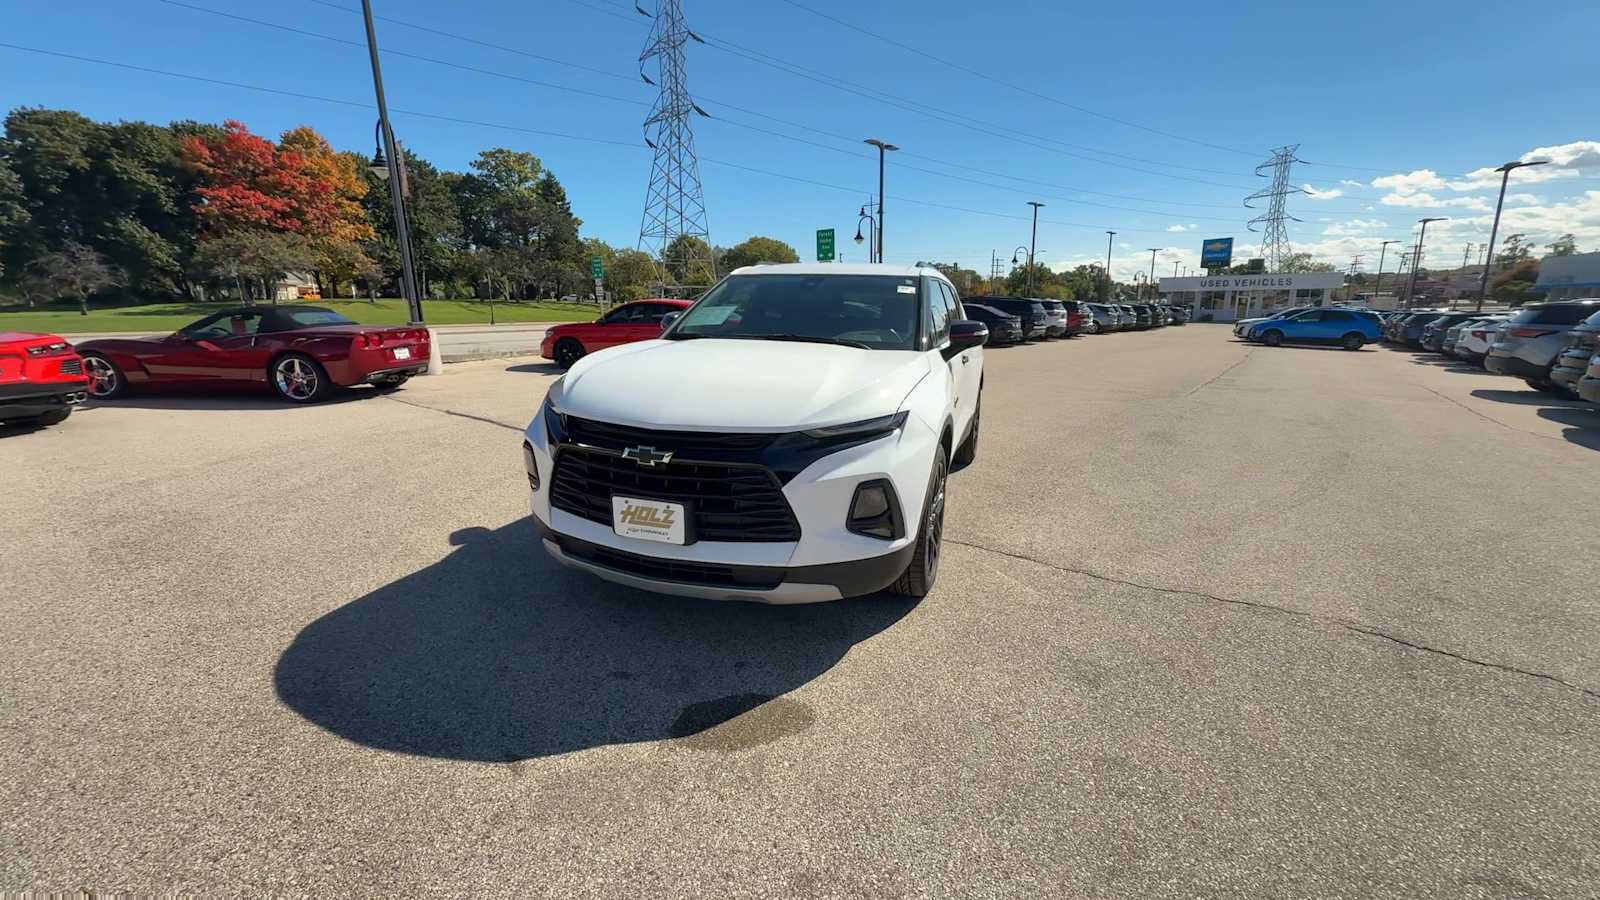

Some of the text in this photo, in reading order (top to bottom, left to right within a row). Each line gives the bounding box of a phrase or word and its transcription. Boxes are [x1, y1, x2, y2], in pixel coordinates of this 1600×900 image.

[1200, 278, 1293, 288] USED VEHICLES
[620, 505, 675, 524] HOLZ
